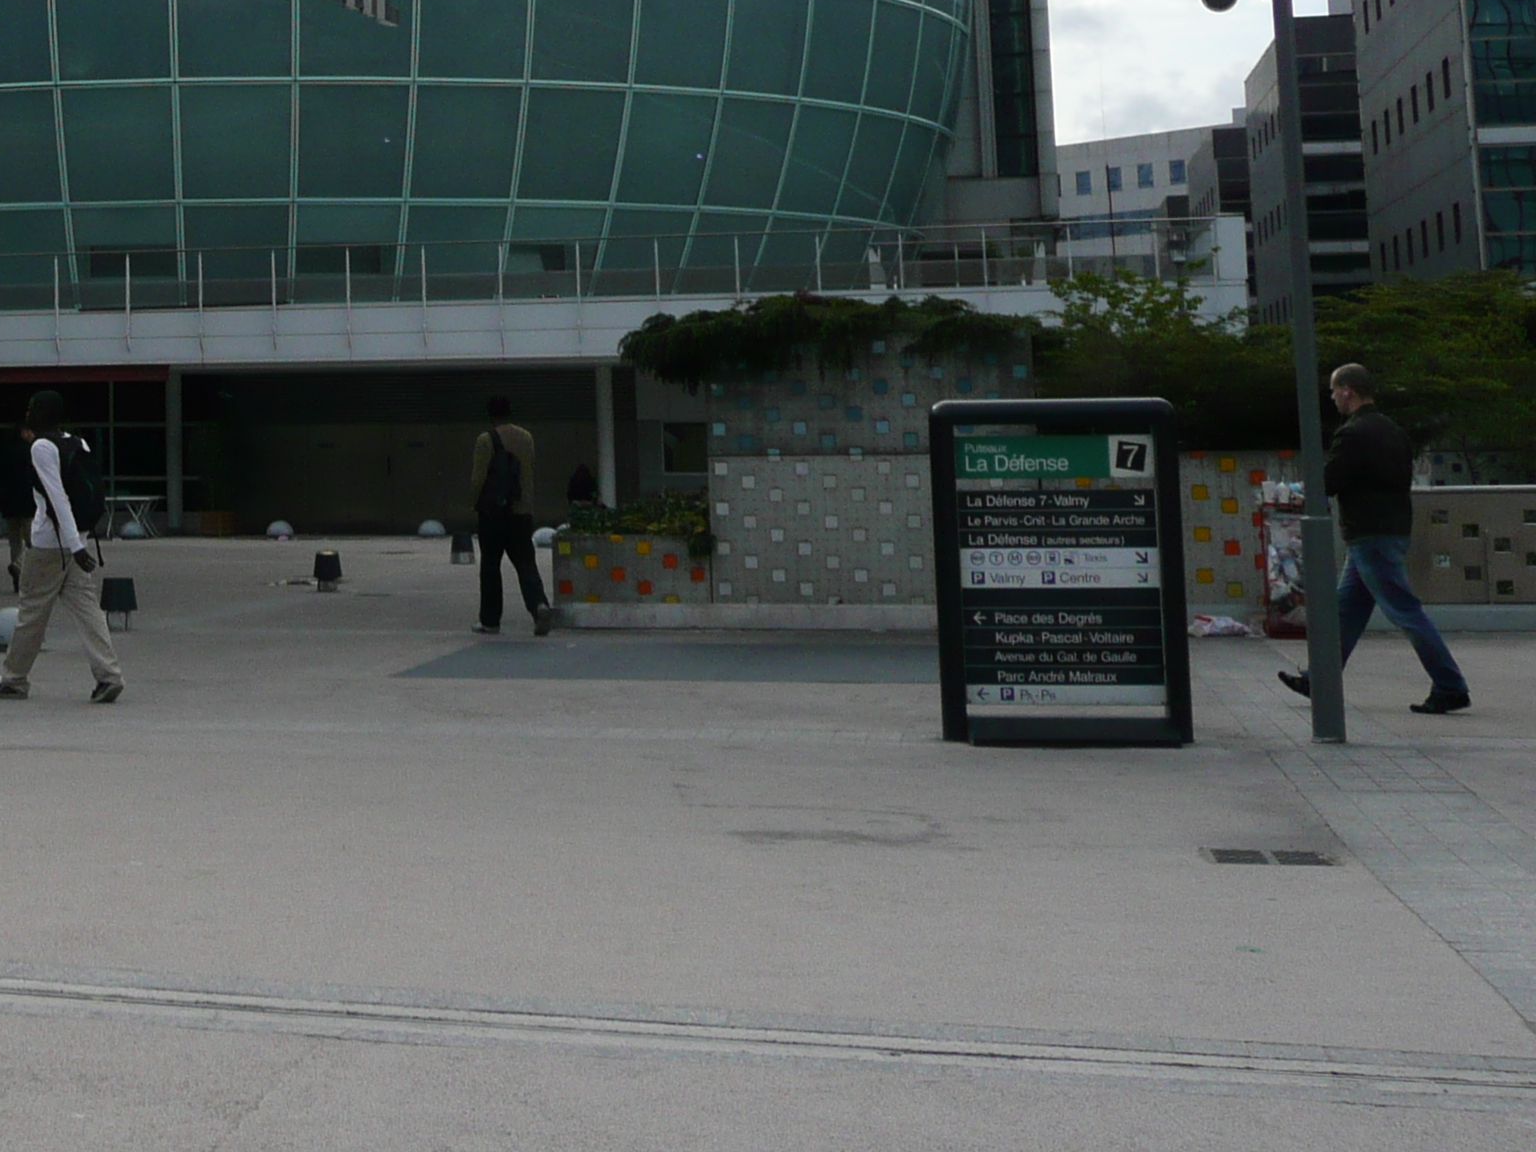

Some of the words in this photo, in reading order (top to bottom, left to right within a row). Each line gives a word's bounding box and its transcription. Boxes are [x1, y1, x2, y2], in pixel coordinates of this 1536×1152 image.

[964, 443, 1008, 453] Puteaux
[965, 455, 988, 473] La
[994, 453, 1069, 473] Défense
[1122, 445, 1139, 468] 7
[966, 496, 982, 507] La
[985, 494, 1036, 507] Défense
[967, 516, 981, 527] Le
[1068, 515, 1110, 526] Grande
[1112, 515, 1145, 526] Arche
[968, 534, 984, 546] La
[987, 533, 1037, 546] Défense
[1083, 553, 1108, 563] Taxis
[989, 572, 1026, 586] Valmy
[1059, 572, 1101, 584] Centre
[994, 612, 1028, 624] Place
[1031, 612, 1058, 624] des
[1058, 612, 1103, 627] Degrés
[994, 651, 1035, 662] Avenue
[1038, 651, 1053, 662] du
[1082, 651, 1097, 662] de
[1100, 651, 1137, 662] Gaulle
[997, 670, 1025, 682] Parc
[1028, 670, 1065, 682] André
[1068, 670, 1117, 682] Malraux
